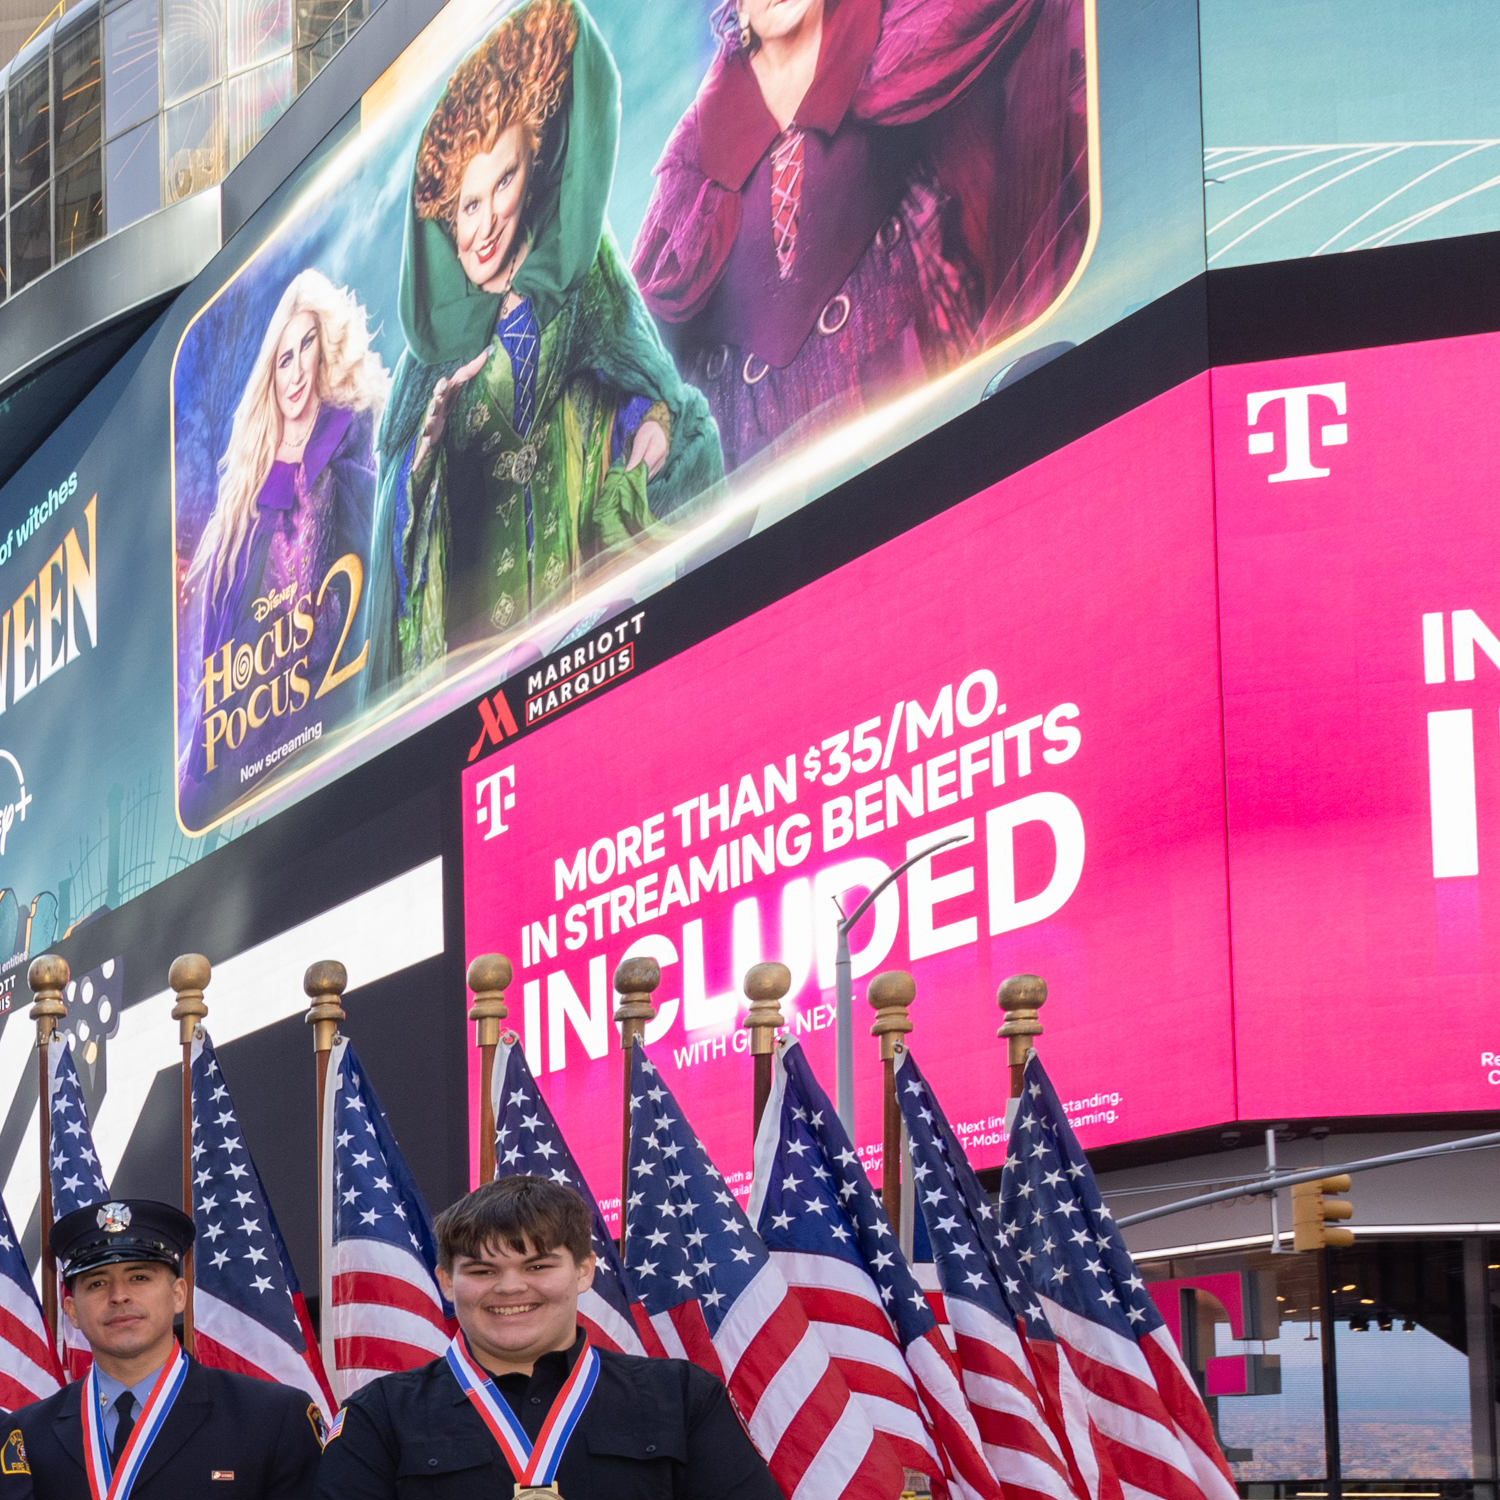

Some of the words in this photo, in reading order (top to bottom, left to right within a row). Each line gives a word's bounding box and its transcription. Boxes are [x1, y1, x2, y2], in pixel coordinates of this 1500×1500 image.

[16, 471, 78, 548] witches
[315, 552, 371, 700] 2
[527, 610, 647, 696] MARRIOTT
[527, 648, 634, 724] MARQUIS
[240, 752, 262, 783] Now
[265, 720, 323, 768] screaming
[553, 810, 665, 902] MORE
[673, 752, 797, 854] THAN
[803, 667, 1008, 788] $35/MO.
[521, 910, 557, 969] IN
[564, 812, 812, 950] STREAMING
[822, 702, 1083, 853] BENEFITS
[522, 791, 1086, 1079] INCLUDED
[674, 1035, 721, 1070] WITH
[956, 1120, 986, 1136] Next
